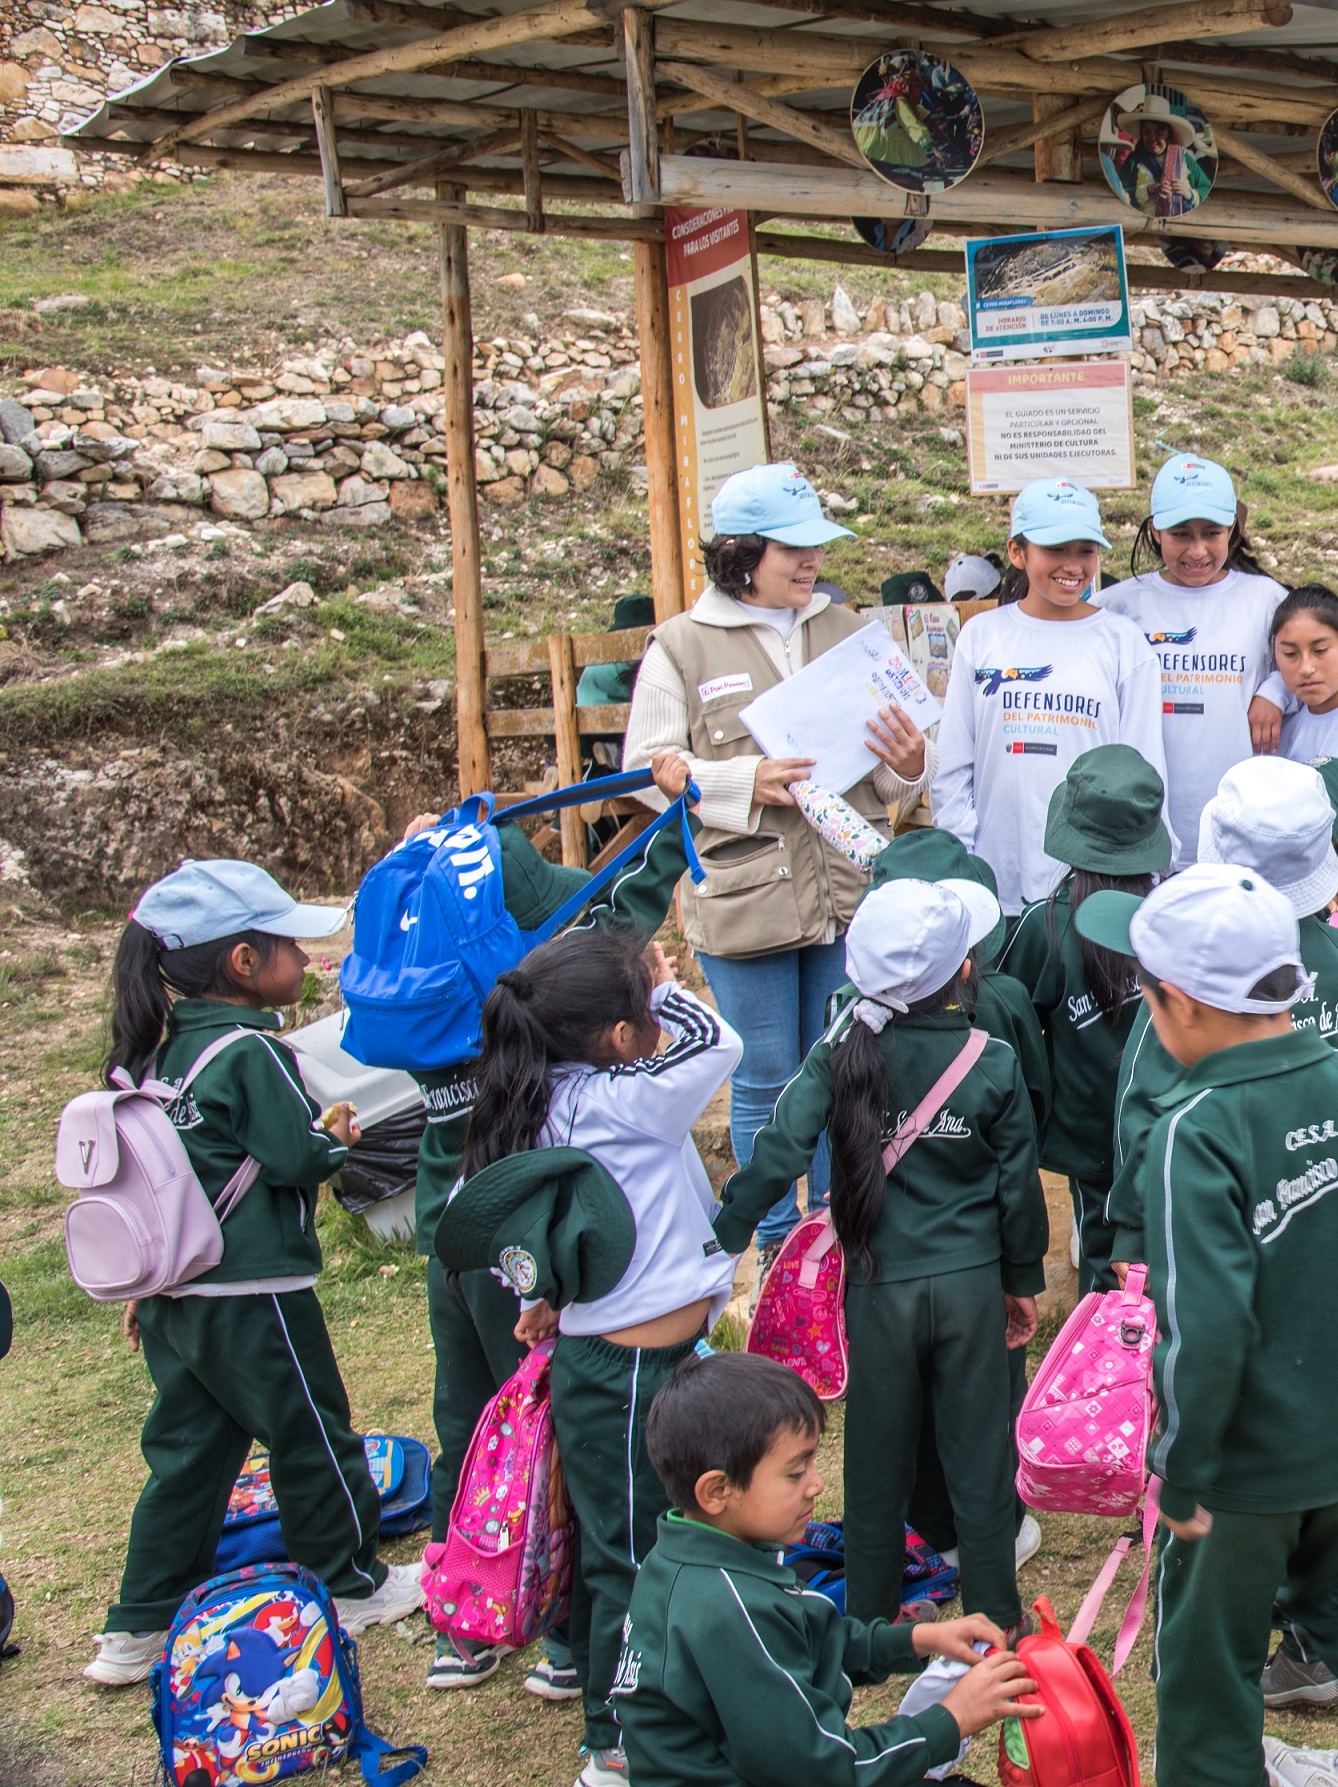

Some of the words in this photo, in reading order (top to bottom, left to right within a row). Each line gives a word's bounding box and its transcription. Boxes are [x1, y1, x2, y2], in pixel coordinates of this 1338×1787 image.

[683, 240, 701, 258] PARA
[700, 233, 711, 252] LOS
[709, 218, 740, 247] VISITANTES
[1050, 311, 1071, 319] LUNES
[1079, 308, 1110, 316] DOMINGO
[998, 316, 1027, 324] HORARIO
[1040, 319, 1049, 327] DE
[996, 322, 1027, 331] ATENCIÓN
[1008, 371, 1085, 385] IMPORTANTE
[1015, 410, 1044, 418] GUIADO
[1055, 408, 1066, 416] UN
[1067, 407, 1100, 415] SERVICIO
[1009, 420, 1053, 428] PARTICULAR
[1061, 418, 1098, 426] OPCIONAL
[1013, 431, 1022, 439] ES
[1023, 429, 1092, 438] RESPONSABILIDAD
[1010, 441, 1052, 449] MINISTERIO
[1065, 439, 1099, 447] CULTURA
[1014, 452, 1029, 460] SUS
[1029, 451, 1068, 459] UNIDADES
[1069, 449, 1118, 458] EJECUTORAS.
[1161, 672, 1173, 682] EL
[1176, 673, 1243, 684] PATRIMONIO
[1161, 684, 1205, 696] ULTURAL
[1003, 691, 1102, 718] DEFENSORES
[1003, 712, 1023, 722] DEL
[1003, 724, 1060, 736] CULTURAL
[1067, 994, 1092, 1022] San
[1319, 1001, 1333, 1032] de
[79, 1139, 96, 1175] V
[246, 1724, 323, 1762] SONIC
[261, 1758, 275, 1768] THE
